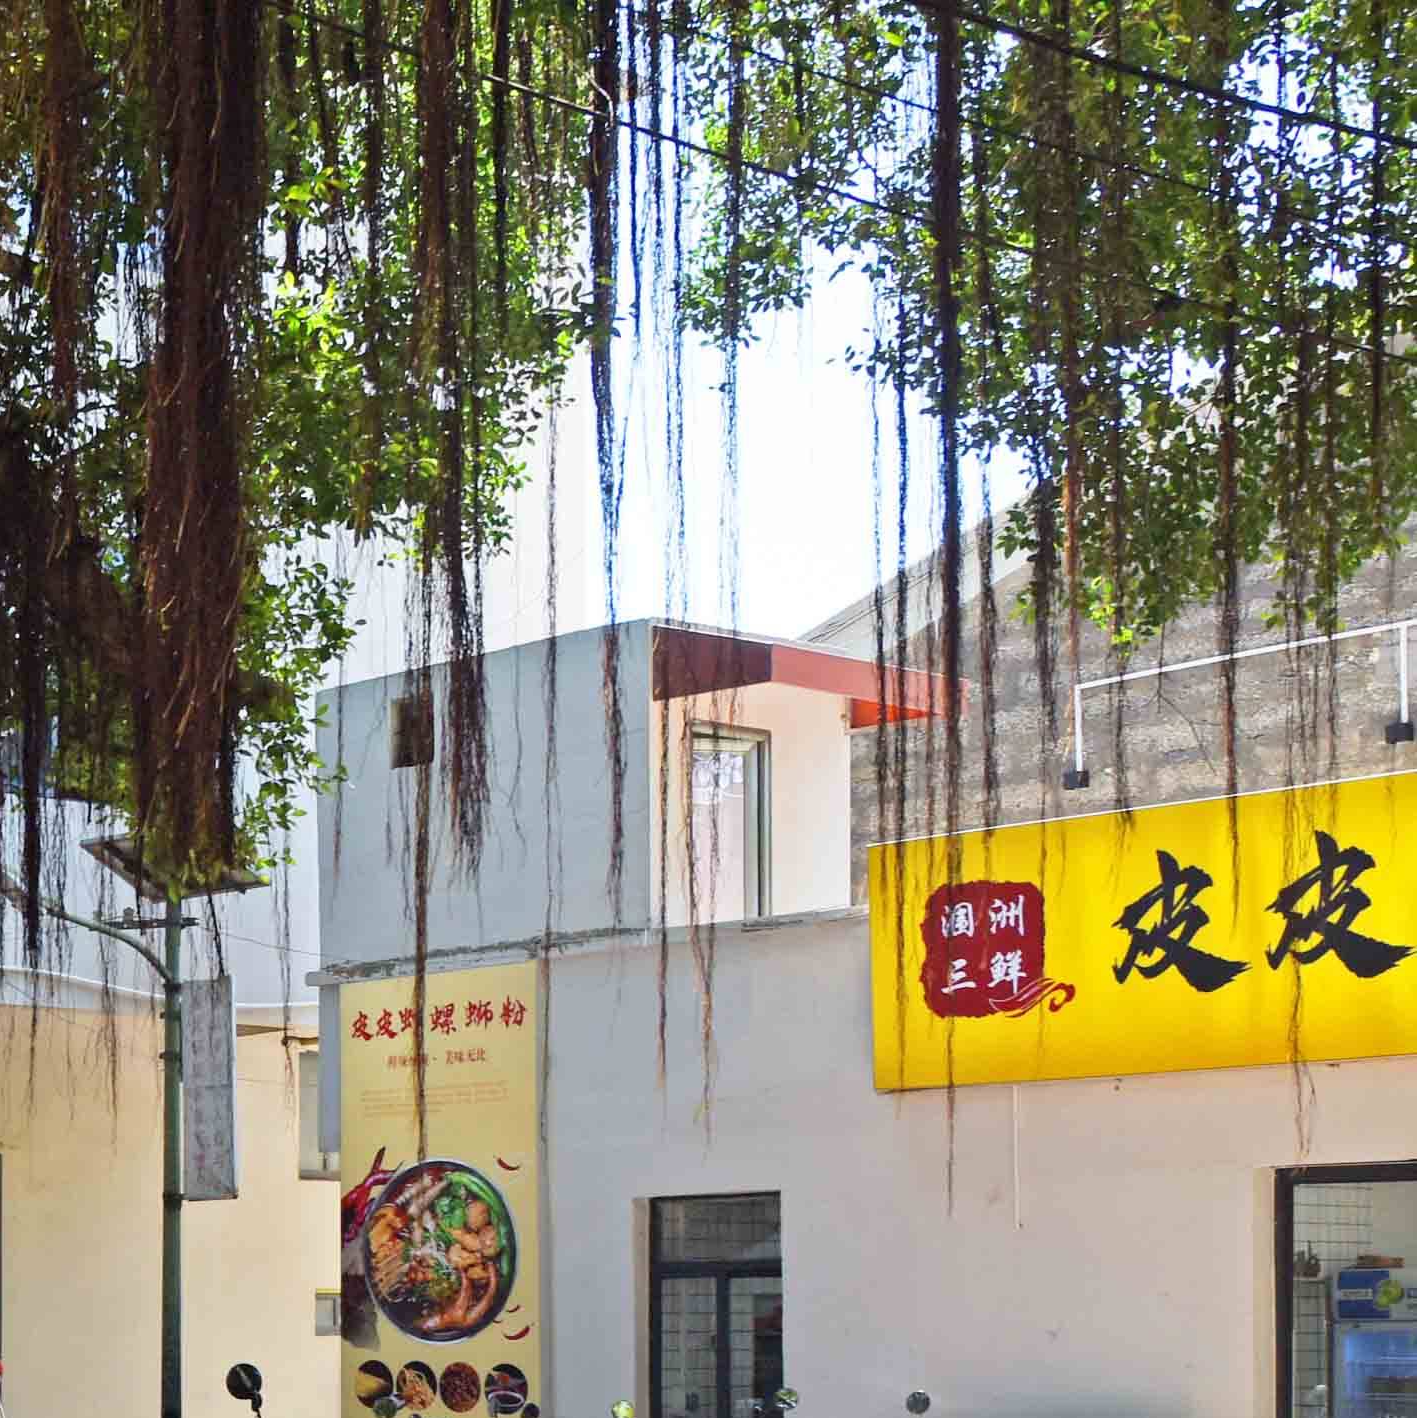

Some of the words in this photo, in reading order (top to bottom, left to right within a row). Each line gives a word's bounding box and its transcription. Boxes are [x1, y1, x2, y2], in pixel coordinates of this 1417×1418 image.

[940, 894, 1025, 937] 涠洲
[1111, 830, 1417, 993] 皮皮
[940, 950, 1026, 994] 三鲜
